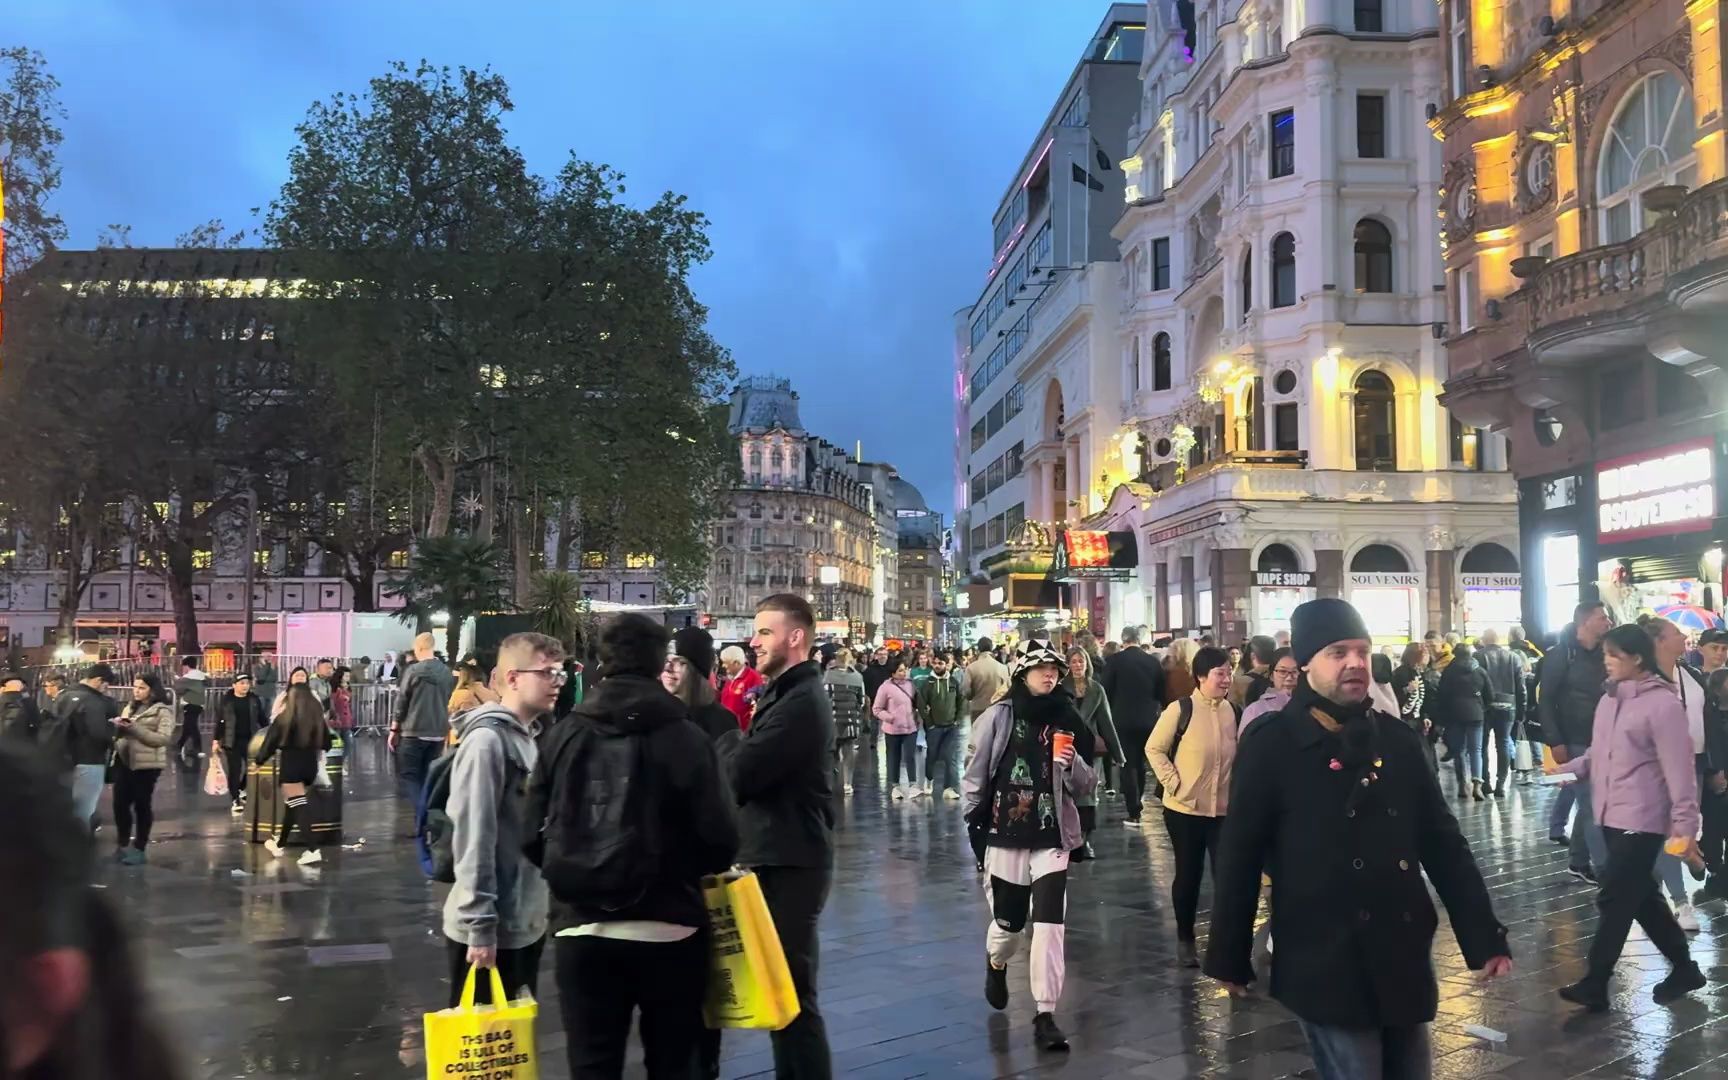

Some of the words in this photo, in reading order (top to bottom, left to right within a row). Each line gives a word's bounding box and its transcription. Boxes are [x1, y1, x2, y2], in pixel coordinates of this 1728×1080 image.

[1256, 572, 1282, 585] VAPE
[1283, 573, 1311, 586] SHOP
[1351, 574, 1420, 586] SOUVENIRS
[1462, 575, 1490, 587] GIFT
[485, 1030, 512, 1043] BAG
[459, 1048, 471, 1059] IS
[498, 1042, 514, 1053] OF
[445, 1053, 529, 1074] COLLECTIBLES
